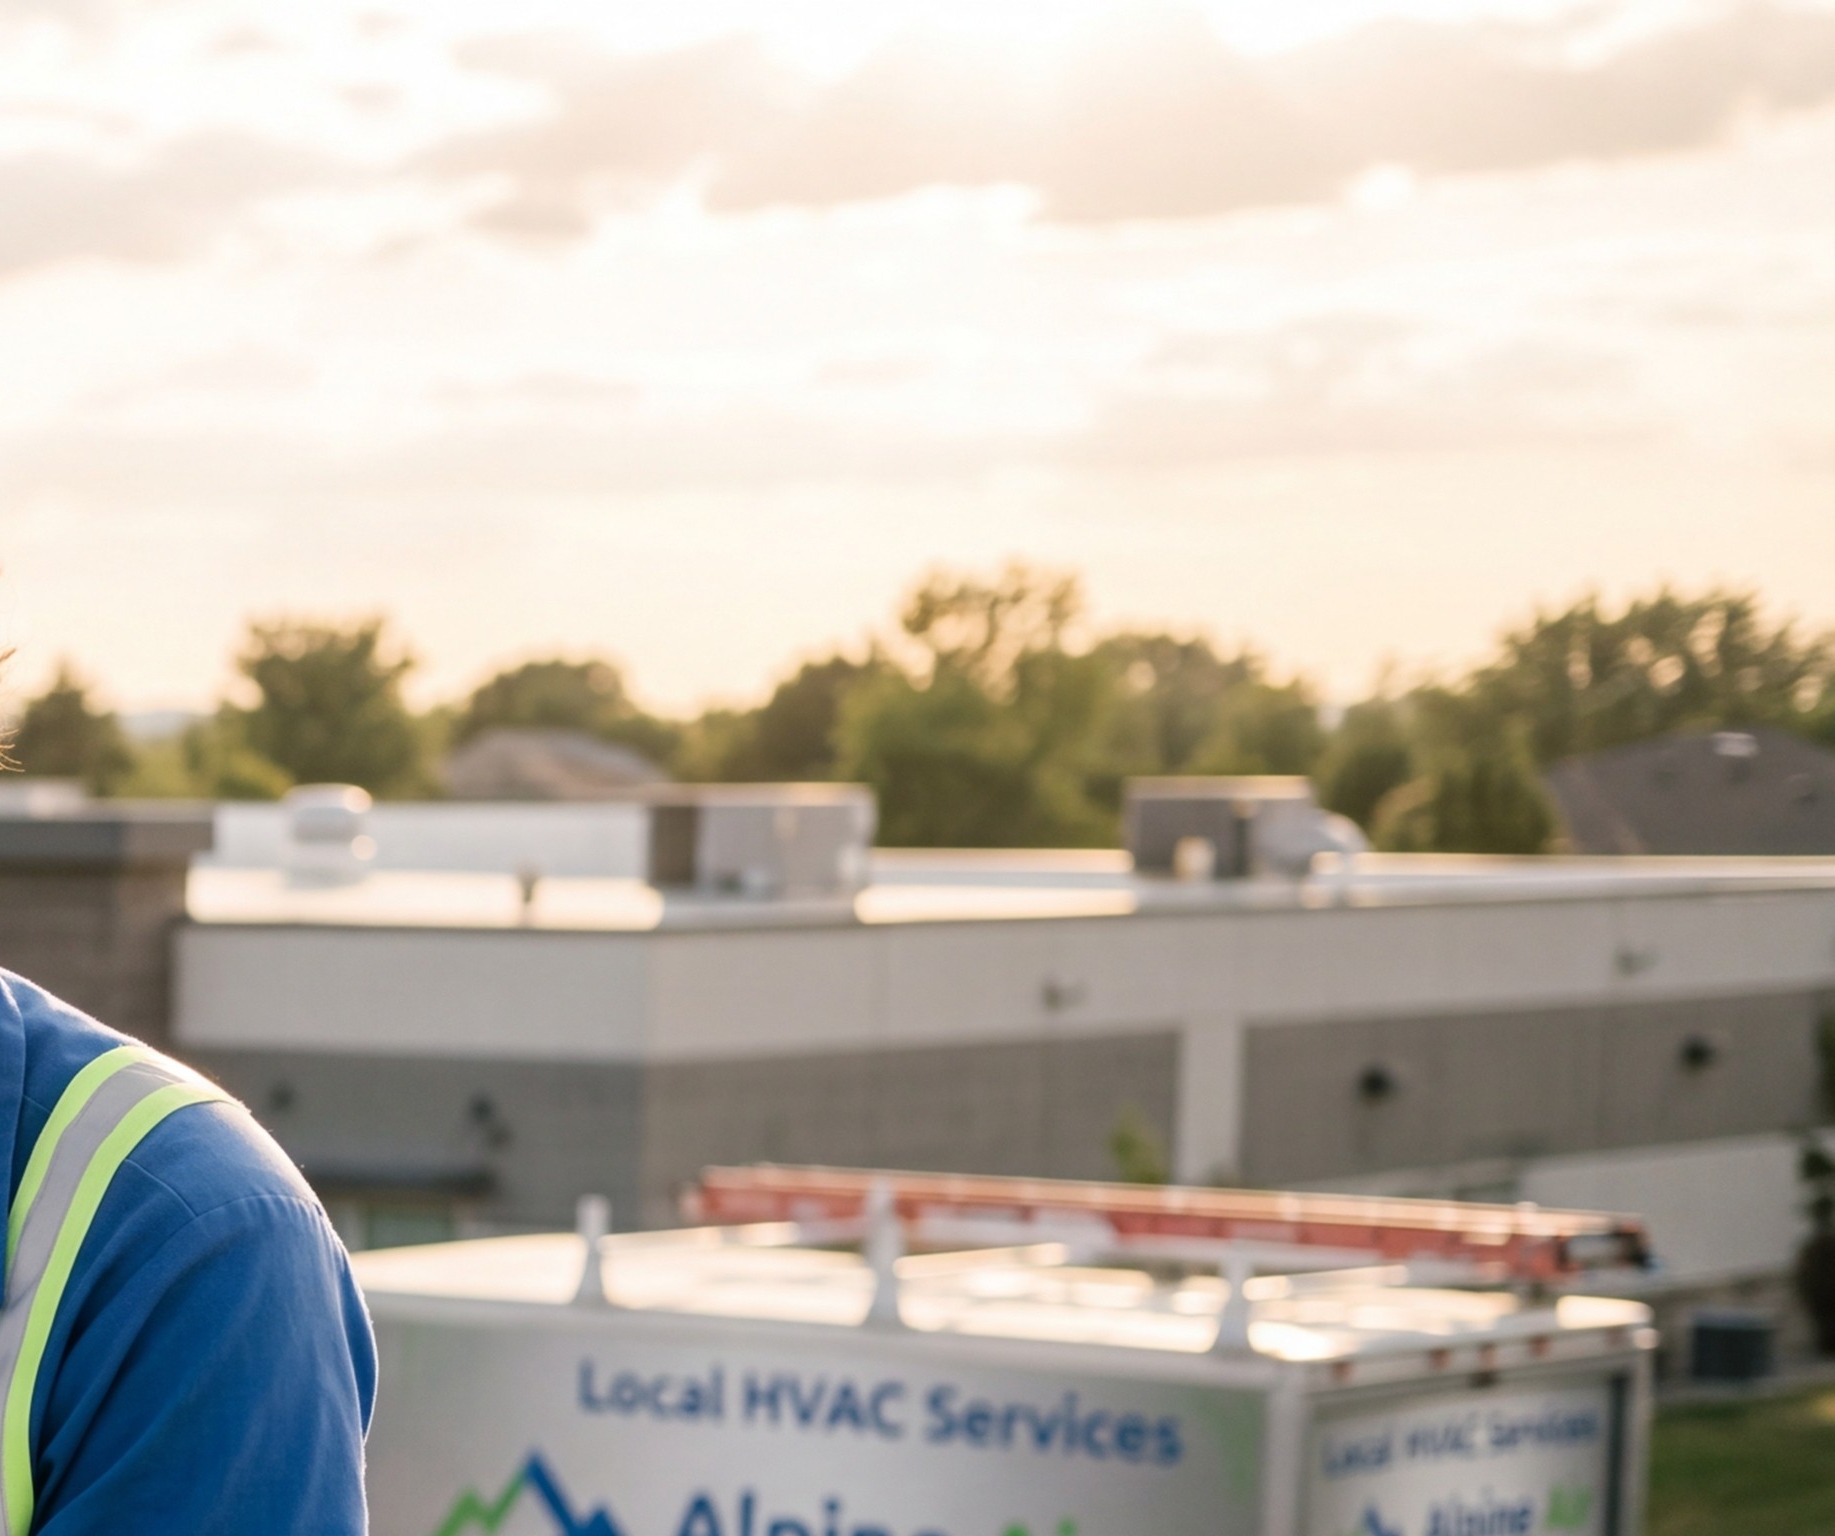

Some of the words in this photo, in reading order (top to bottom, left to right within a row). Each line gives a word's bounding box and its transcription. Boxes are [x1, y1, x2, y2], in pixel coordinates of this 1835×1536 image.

[579, 1357, 725, 1421] Local
[743, 1369, 908, 1438] HVAC
[924, 1384, 1184, 1467] Services
